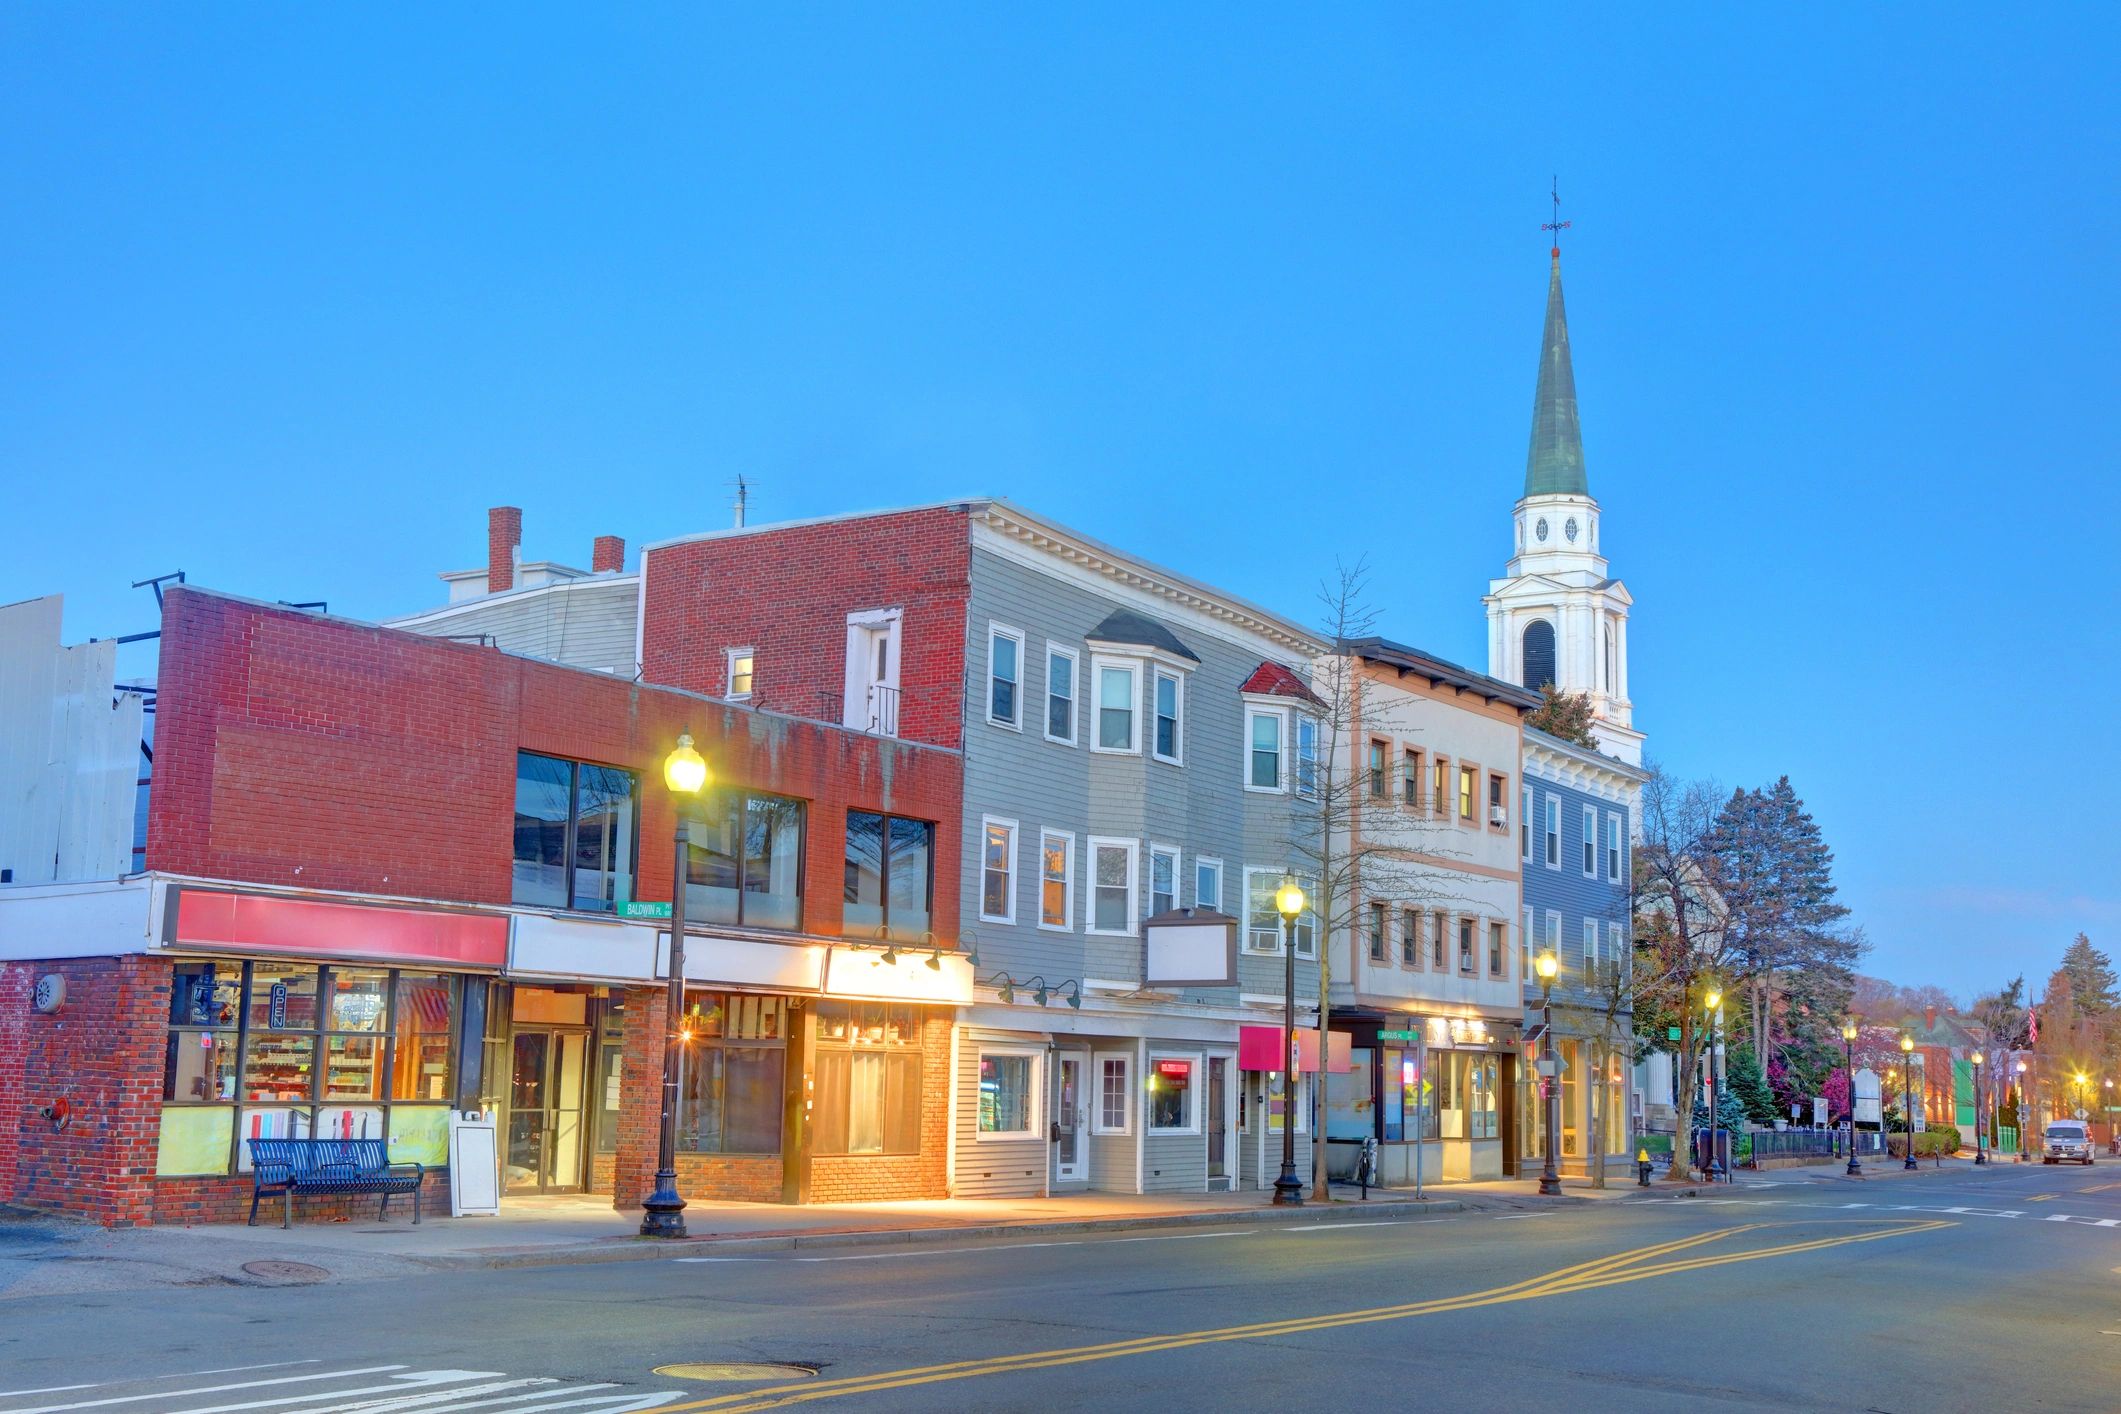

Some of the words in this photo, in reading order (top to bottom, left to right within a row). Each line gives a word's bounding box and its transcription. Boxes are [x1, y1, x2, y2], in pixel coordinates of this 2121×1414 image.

[627, 903, 655, 915] BALDWIN
[656, 907, 662, 916] PL
[273, 987, 285, 1027] OPEN
